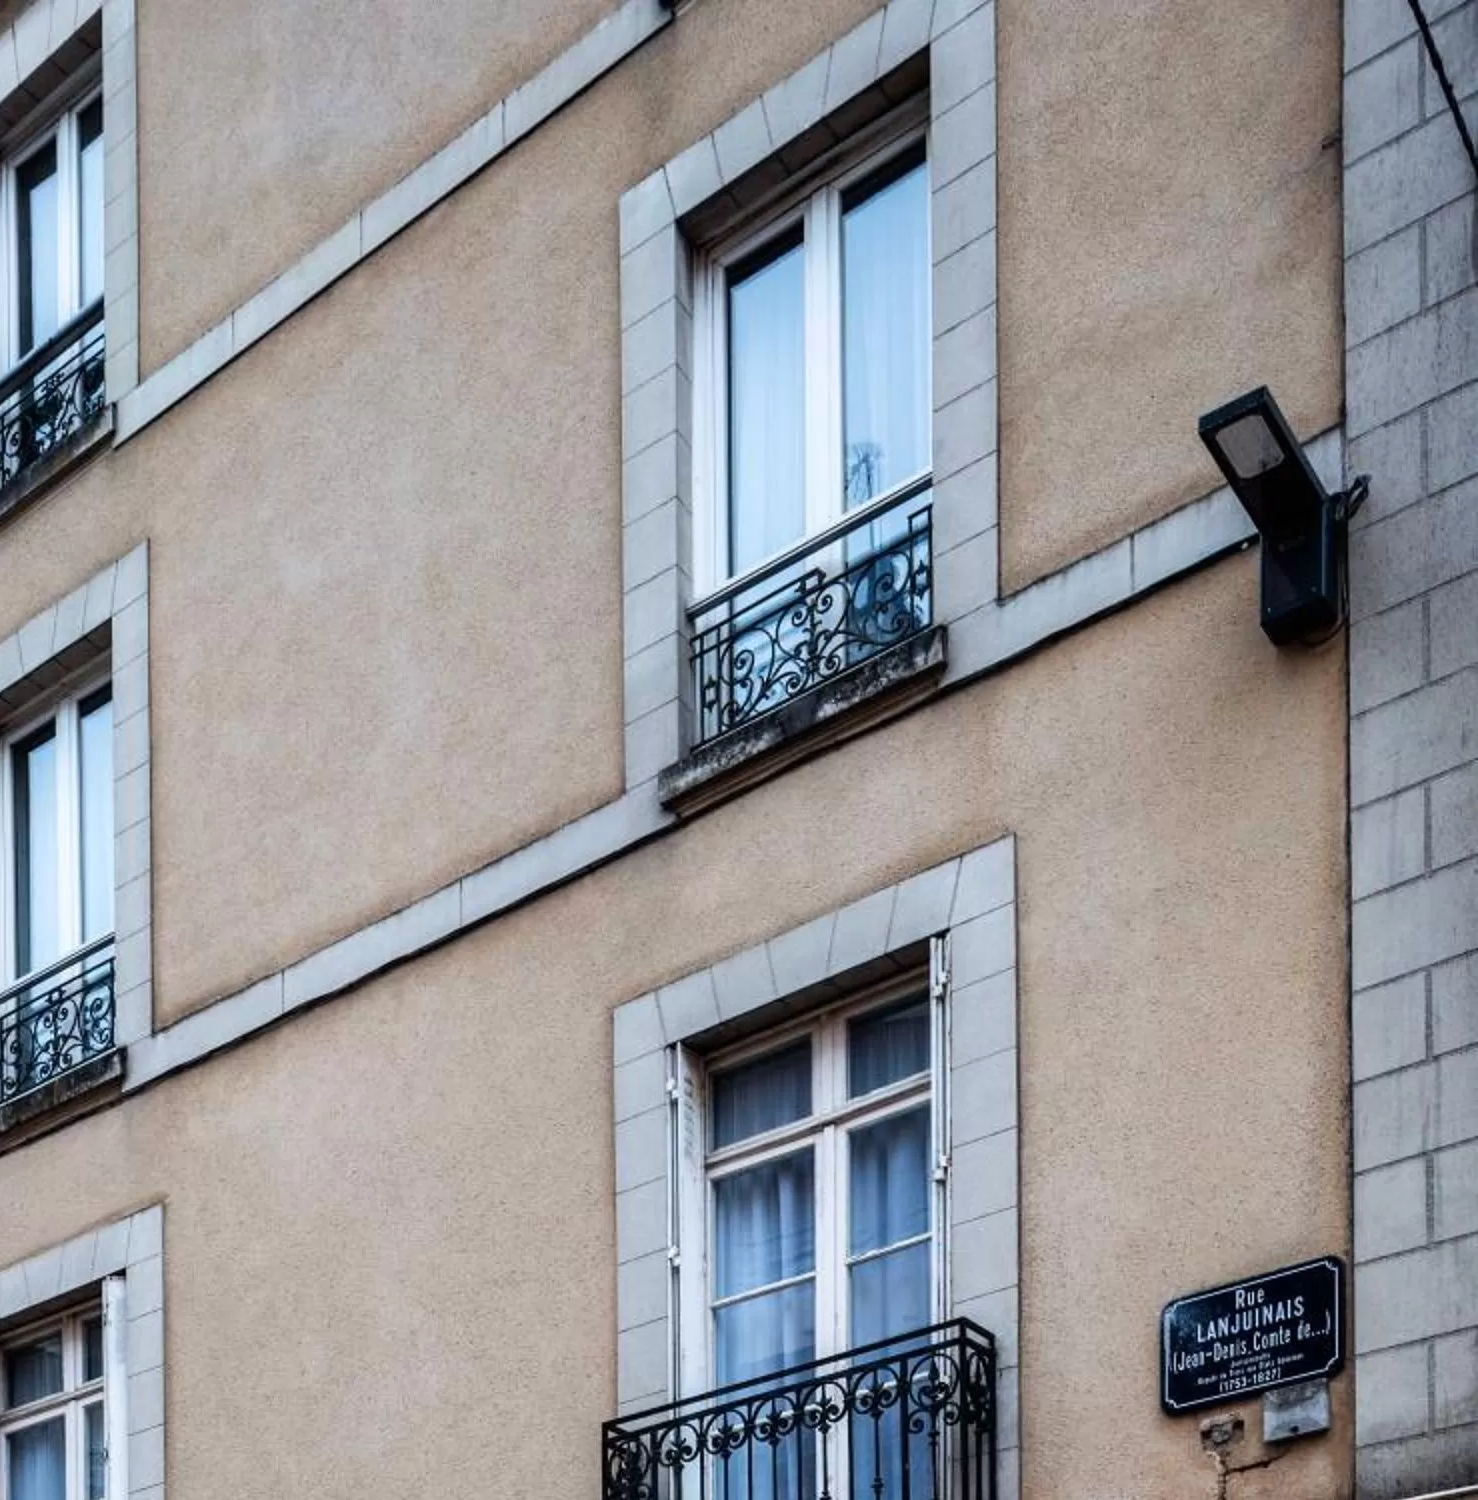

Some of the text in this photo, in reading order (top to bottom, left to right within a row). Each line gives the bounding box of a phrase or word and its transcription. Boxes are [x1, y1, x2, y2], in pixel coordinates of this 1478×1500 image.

[1235, 1288, 1265, 1310] Rue
[1196, 1296, 1305, 1343] LANJUINAIS
[1253, 1325, 1291, 1351] Comte
